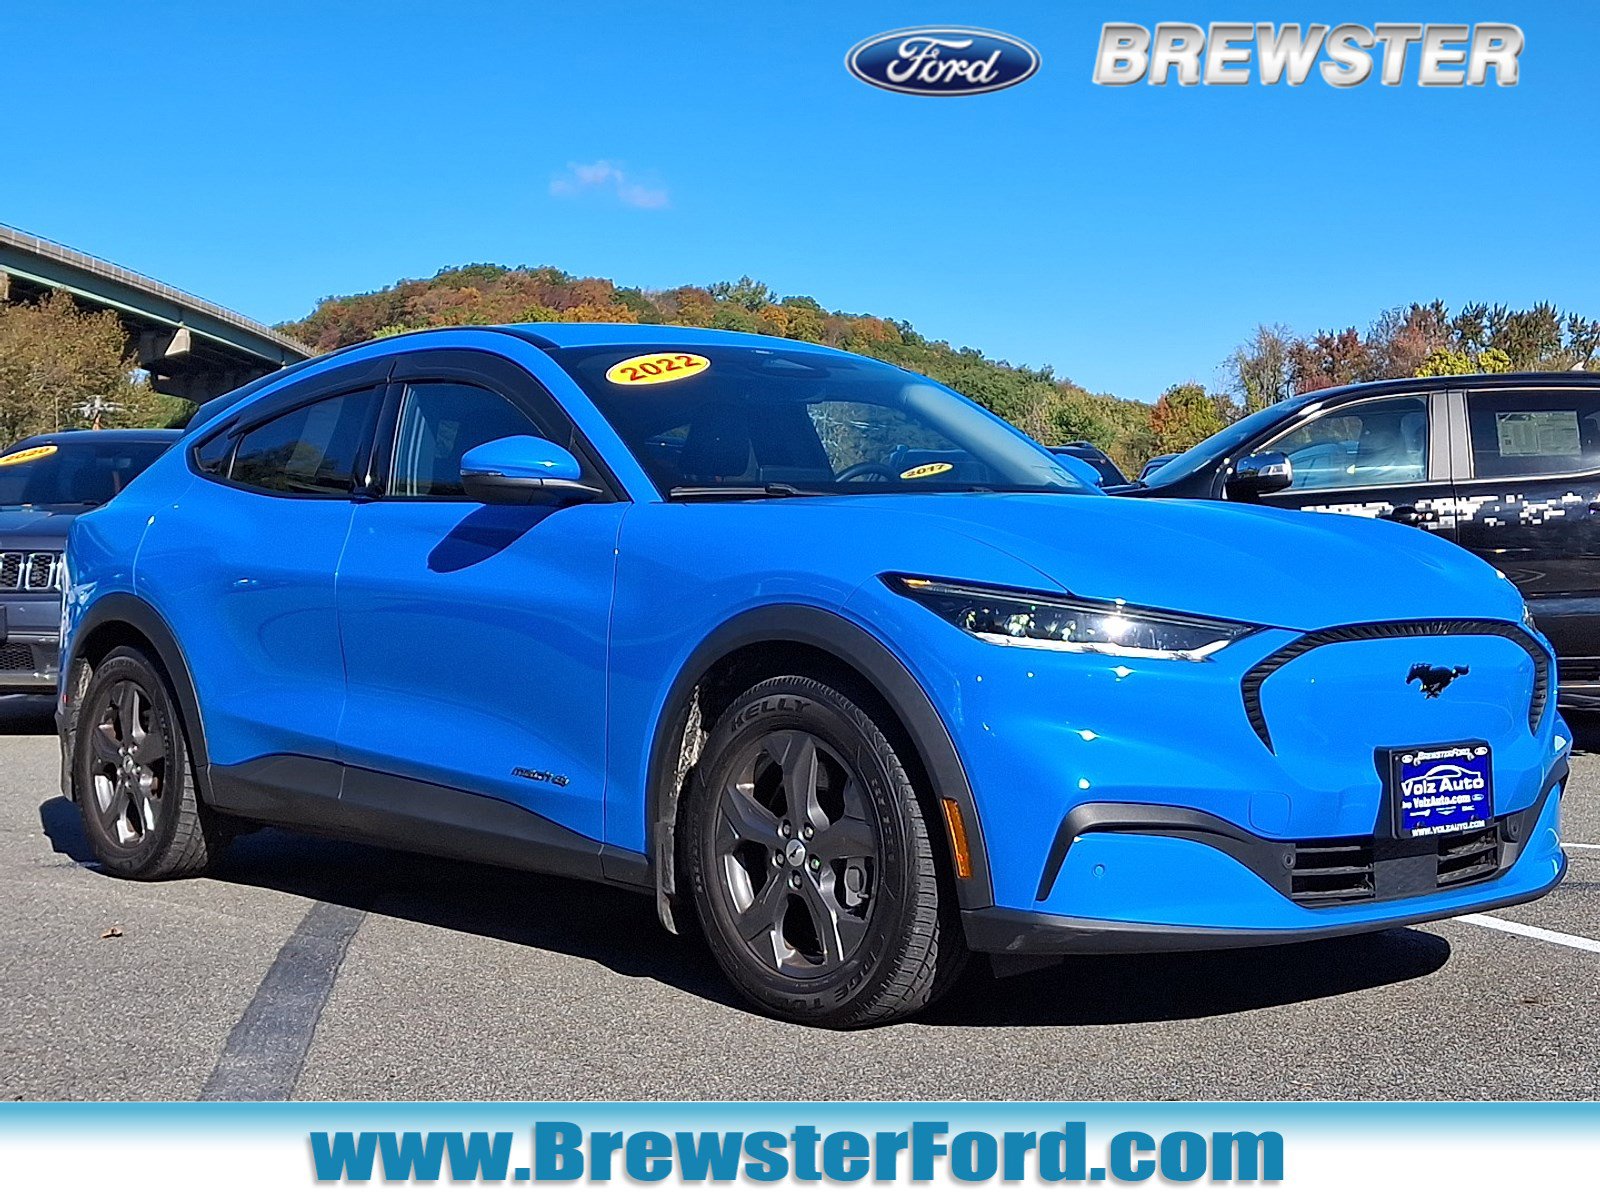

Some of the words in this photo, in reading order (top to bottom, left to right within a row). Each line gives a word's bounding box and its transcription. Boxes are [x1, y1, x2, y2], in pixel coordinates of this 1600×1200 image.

[620, 355, 702, 381] 2022
[906, 464, 945, 477] 2017
[731, 697, 811, 732] KELLY
[1401, 780, 1437, 796] Volz
[1439, 777, 1485, 792] Auto
[1413, 794, 1471, 808] VolzAuto.com
